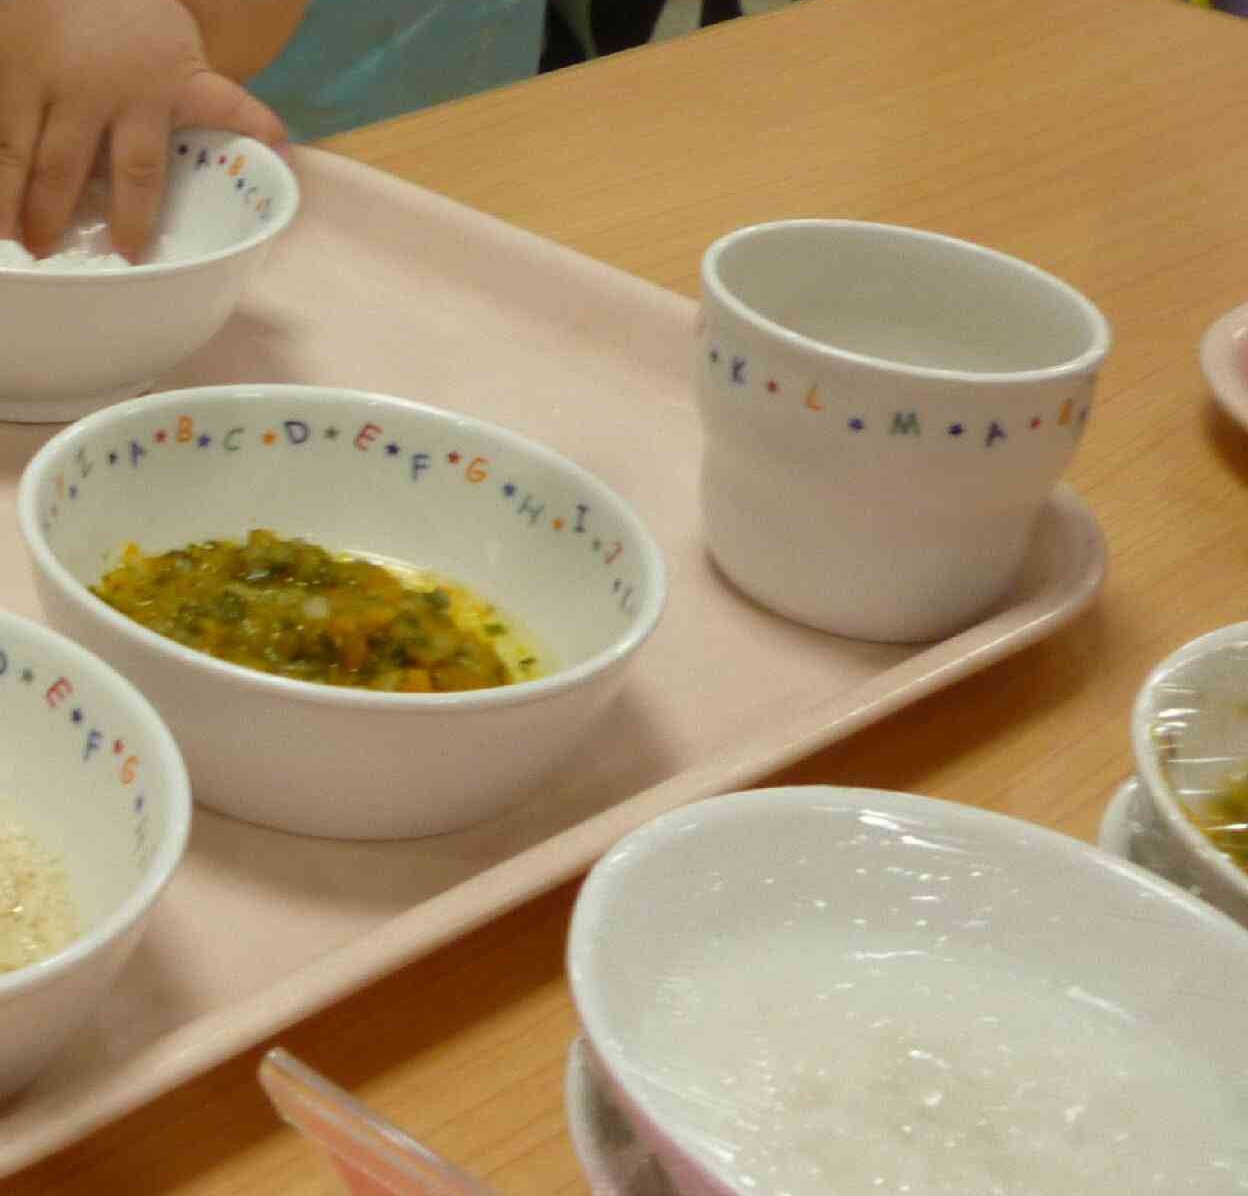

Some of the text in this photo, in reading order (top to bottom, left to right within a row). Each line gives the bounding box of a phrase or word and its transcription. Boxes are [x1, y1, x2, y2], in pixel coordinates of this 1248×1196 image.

[804, 384, 824, 412] L
[889, 412, 921, 436] M
[983, 421, 1008, 448] A
[176, 414, 193, 443] B
[223, 427, 244, 451] C
[284, 420, 309, 445] D
[354, 422, 383, 452] E
[412, 453, 432, 481] F
[465, 457, 489, 484] G
[518, 494, 543, 525] H
[573, 504, 590, 533] I
[45, 676, 73, 708] E
[81, 726, 104, 763] F
[118, 754, 140, 788] G
